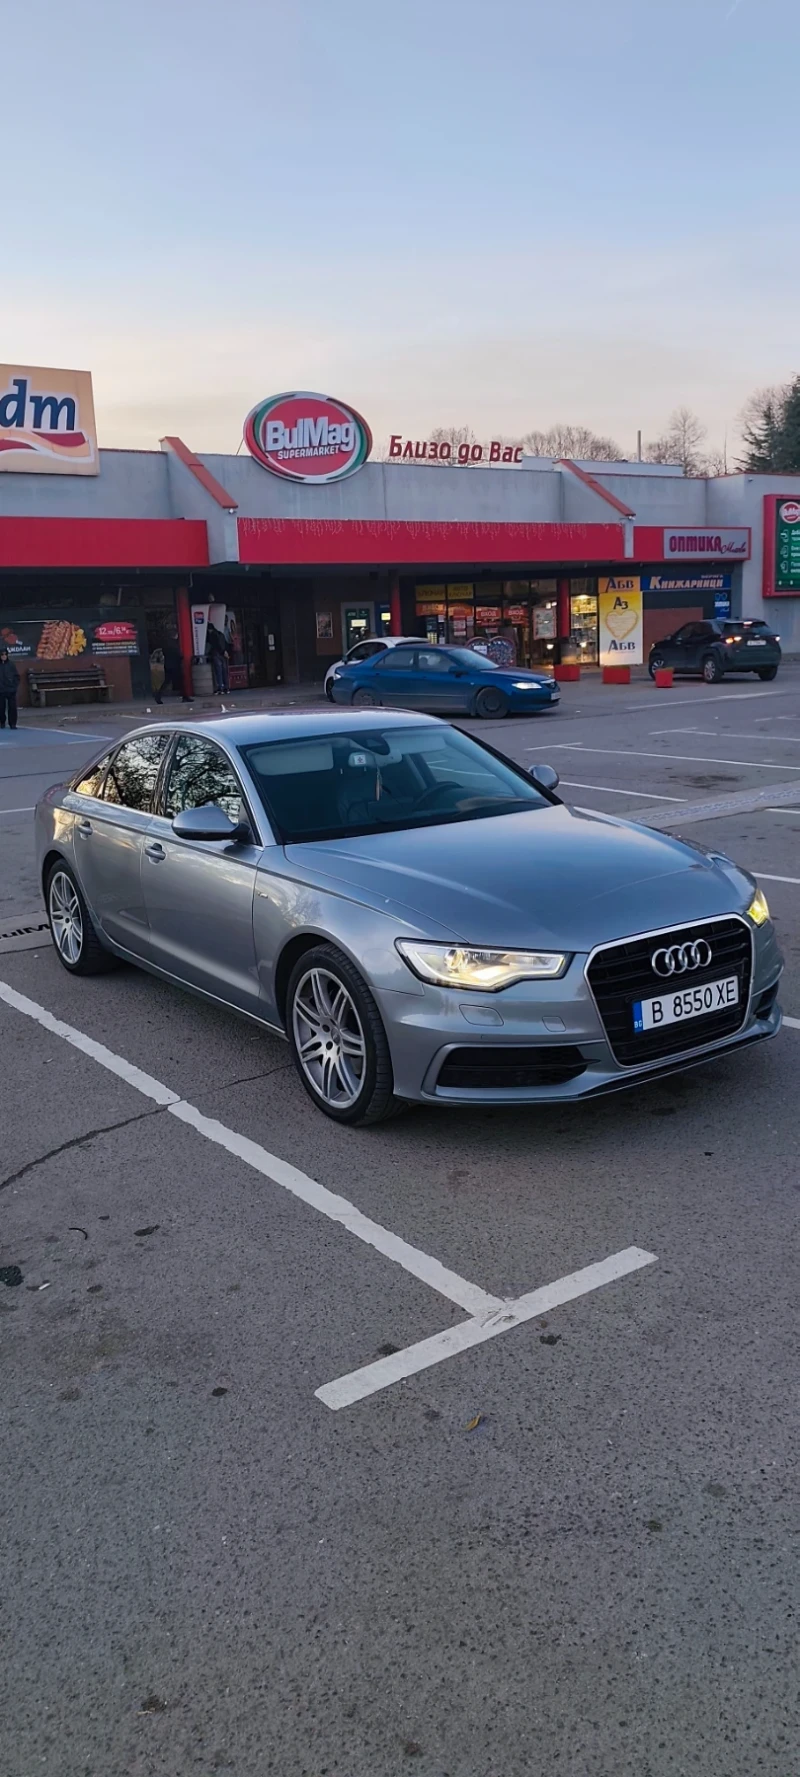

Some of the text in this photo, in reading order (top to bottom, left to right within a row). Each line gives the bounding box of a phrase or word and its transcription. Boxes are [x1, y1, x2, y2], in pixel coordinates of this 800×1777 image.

[0, 379, 75, 431] dm
[265, 417, 355, 452] BulMag
[277, 445, 340, 460] SUPERMARKET
[389, 435, 524, 464] Близо до Вас
[669, 535, 721, 552] ОПТИКА
[605, 577, 634, 593] АБВ
[608, 640, 636, 654] АБВ
[651, 980, 736, 1024] B 8550 XE
[634, 1020, 642, 1029] BG
